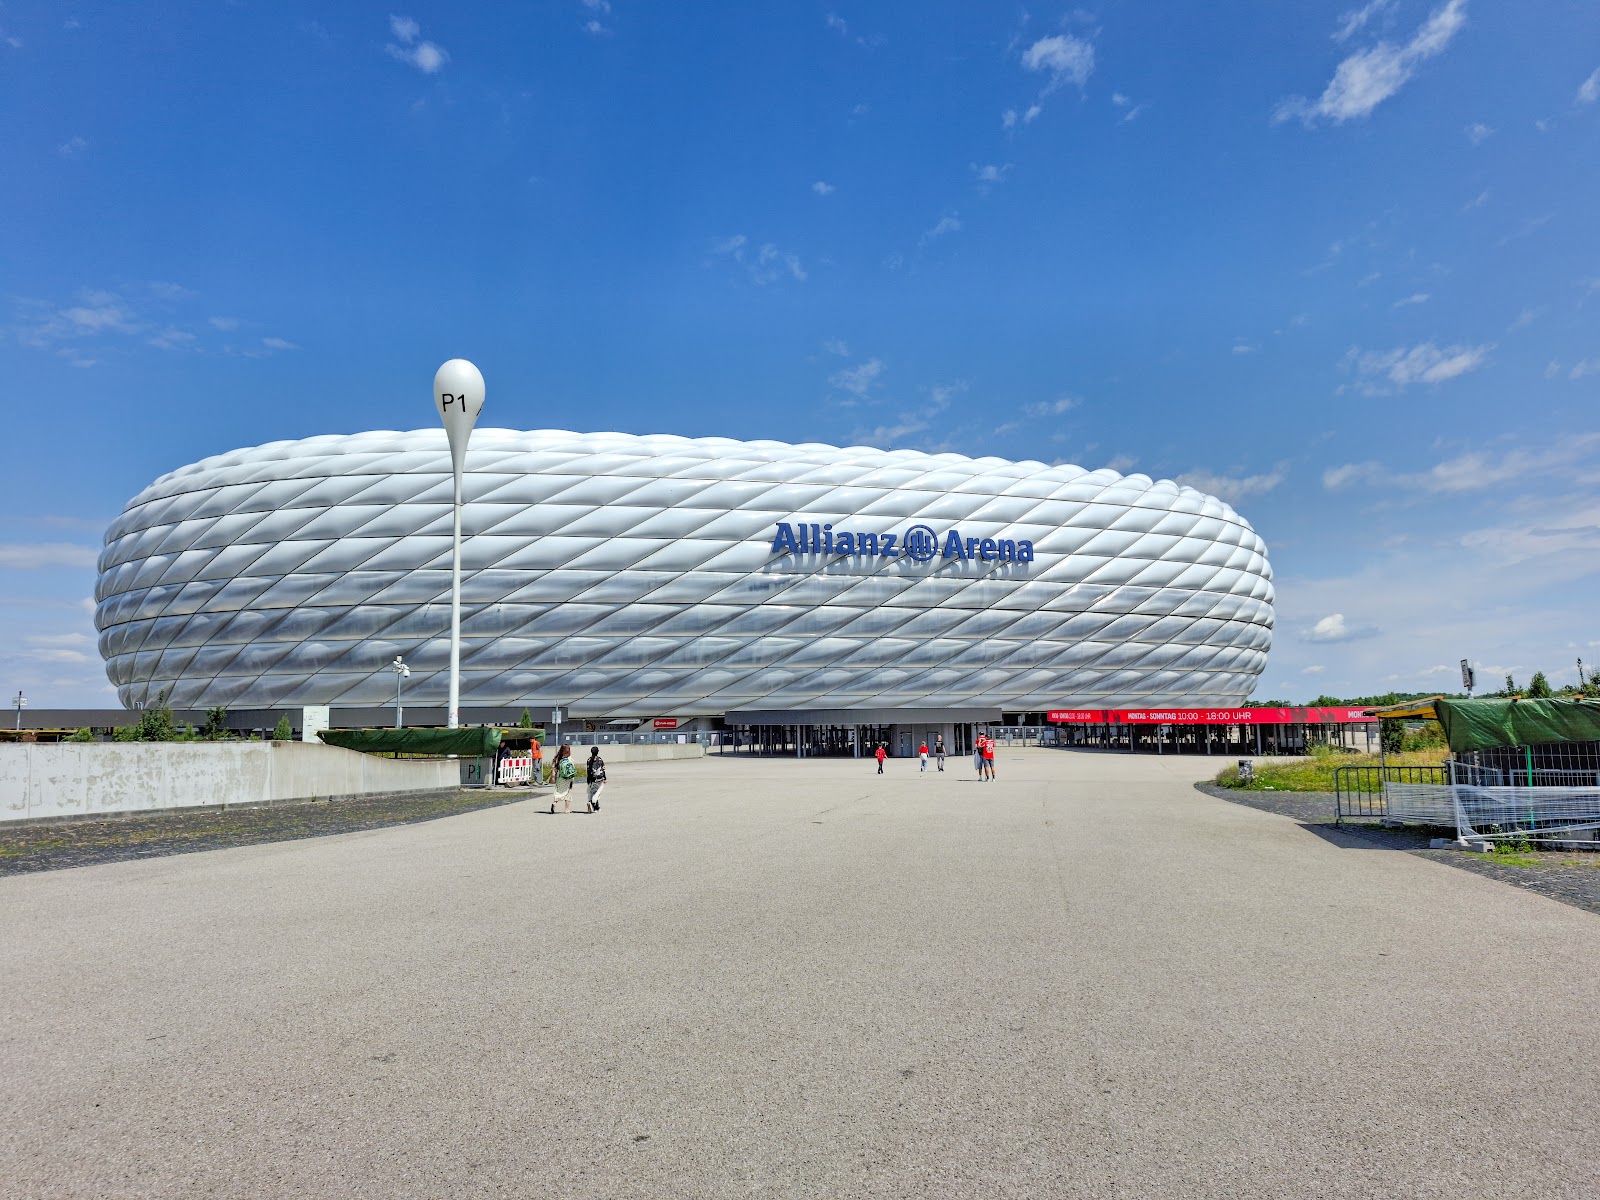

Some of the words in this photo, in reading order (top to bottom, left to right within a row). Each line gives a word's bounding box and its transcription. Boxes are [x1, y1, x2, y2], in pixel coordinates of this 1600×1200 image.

[441, 393, 466, 413] P1
[771, 522, 899, 557] Allianz
[943, 529, 1034, 562] Arena
[1127, 712, 1147, 720] MONTAG
[1150, 712, 1177, 720] SONNTAG
[1177, 712, 1199, 720] 10:00
[1206, 712, 1230, 720] 18:00
[1232, 711, 1252, 720] UHR
